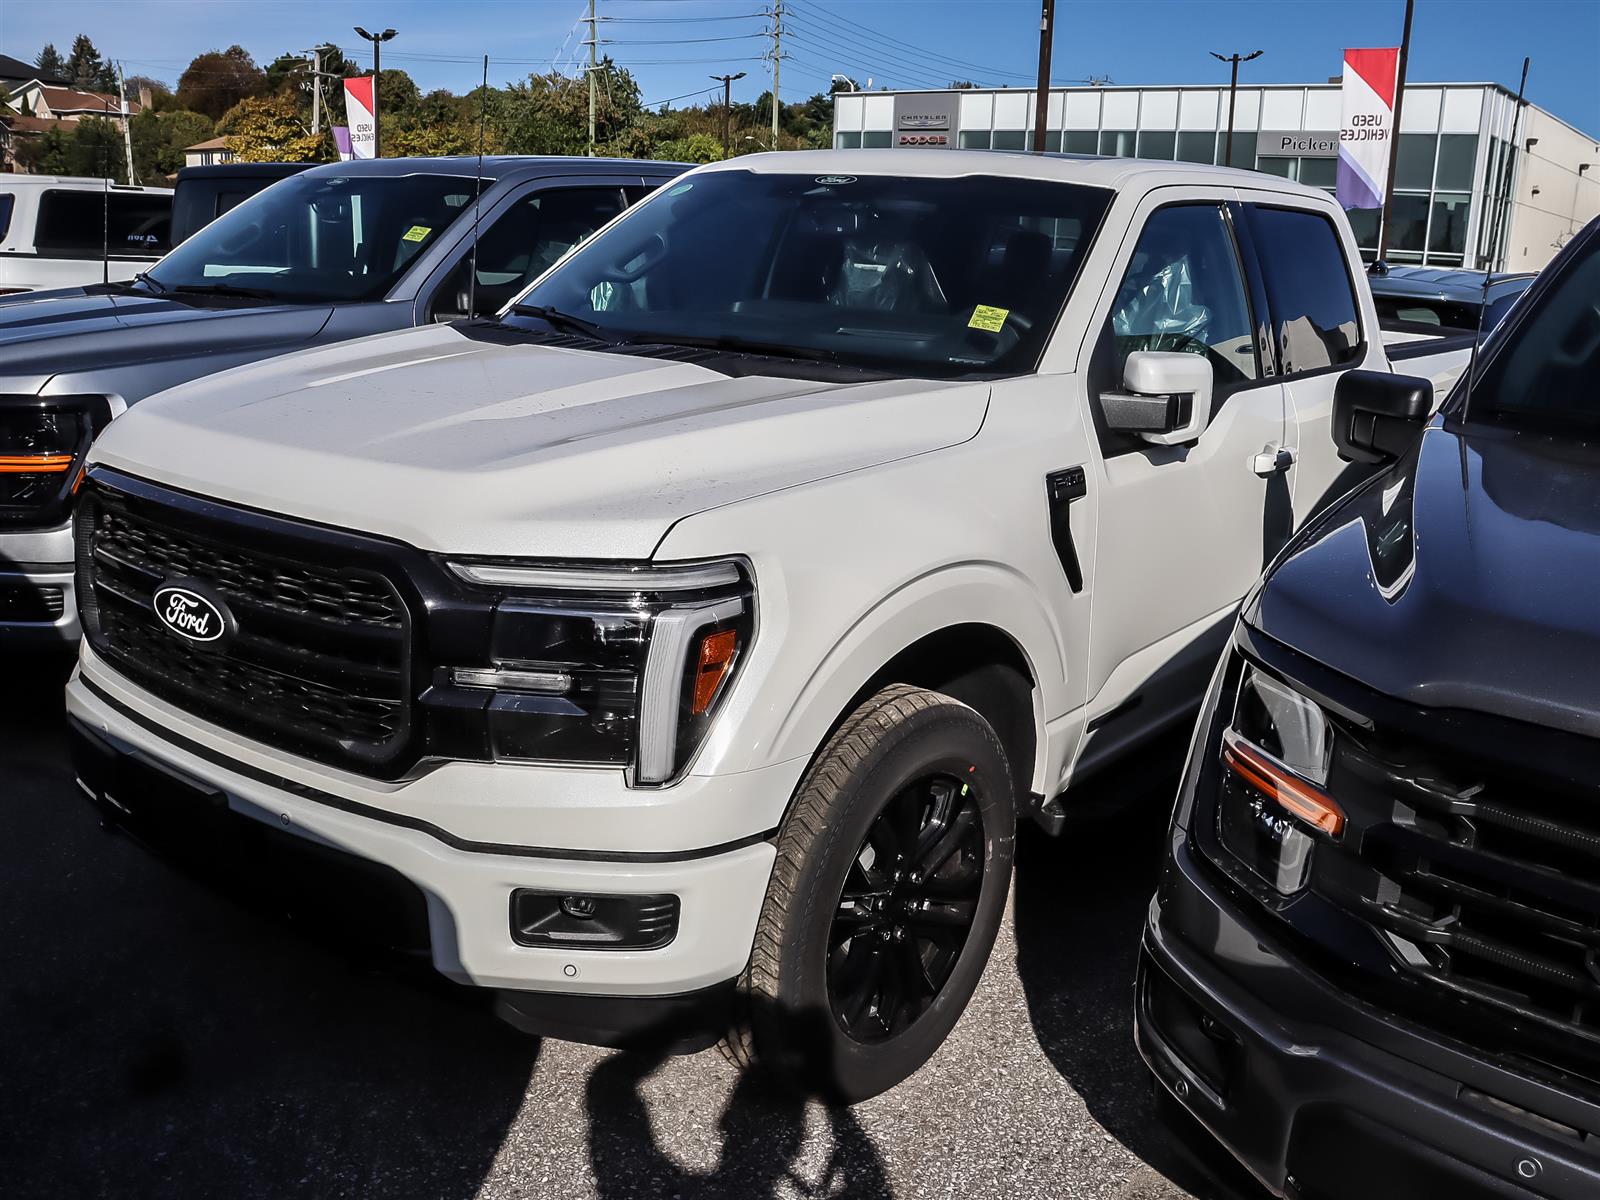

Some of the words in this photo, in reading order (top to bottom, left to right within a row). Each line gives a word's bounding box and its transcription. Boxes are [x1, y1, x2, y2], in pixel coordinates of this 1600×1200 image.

[899, 135, 947, 145] DODGE
[1281, 137, 1339, 151] Picker
[165, 593, 210, 636] Ford
